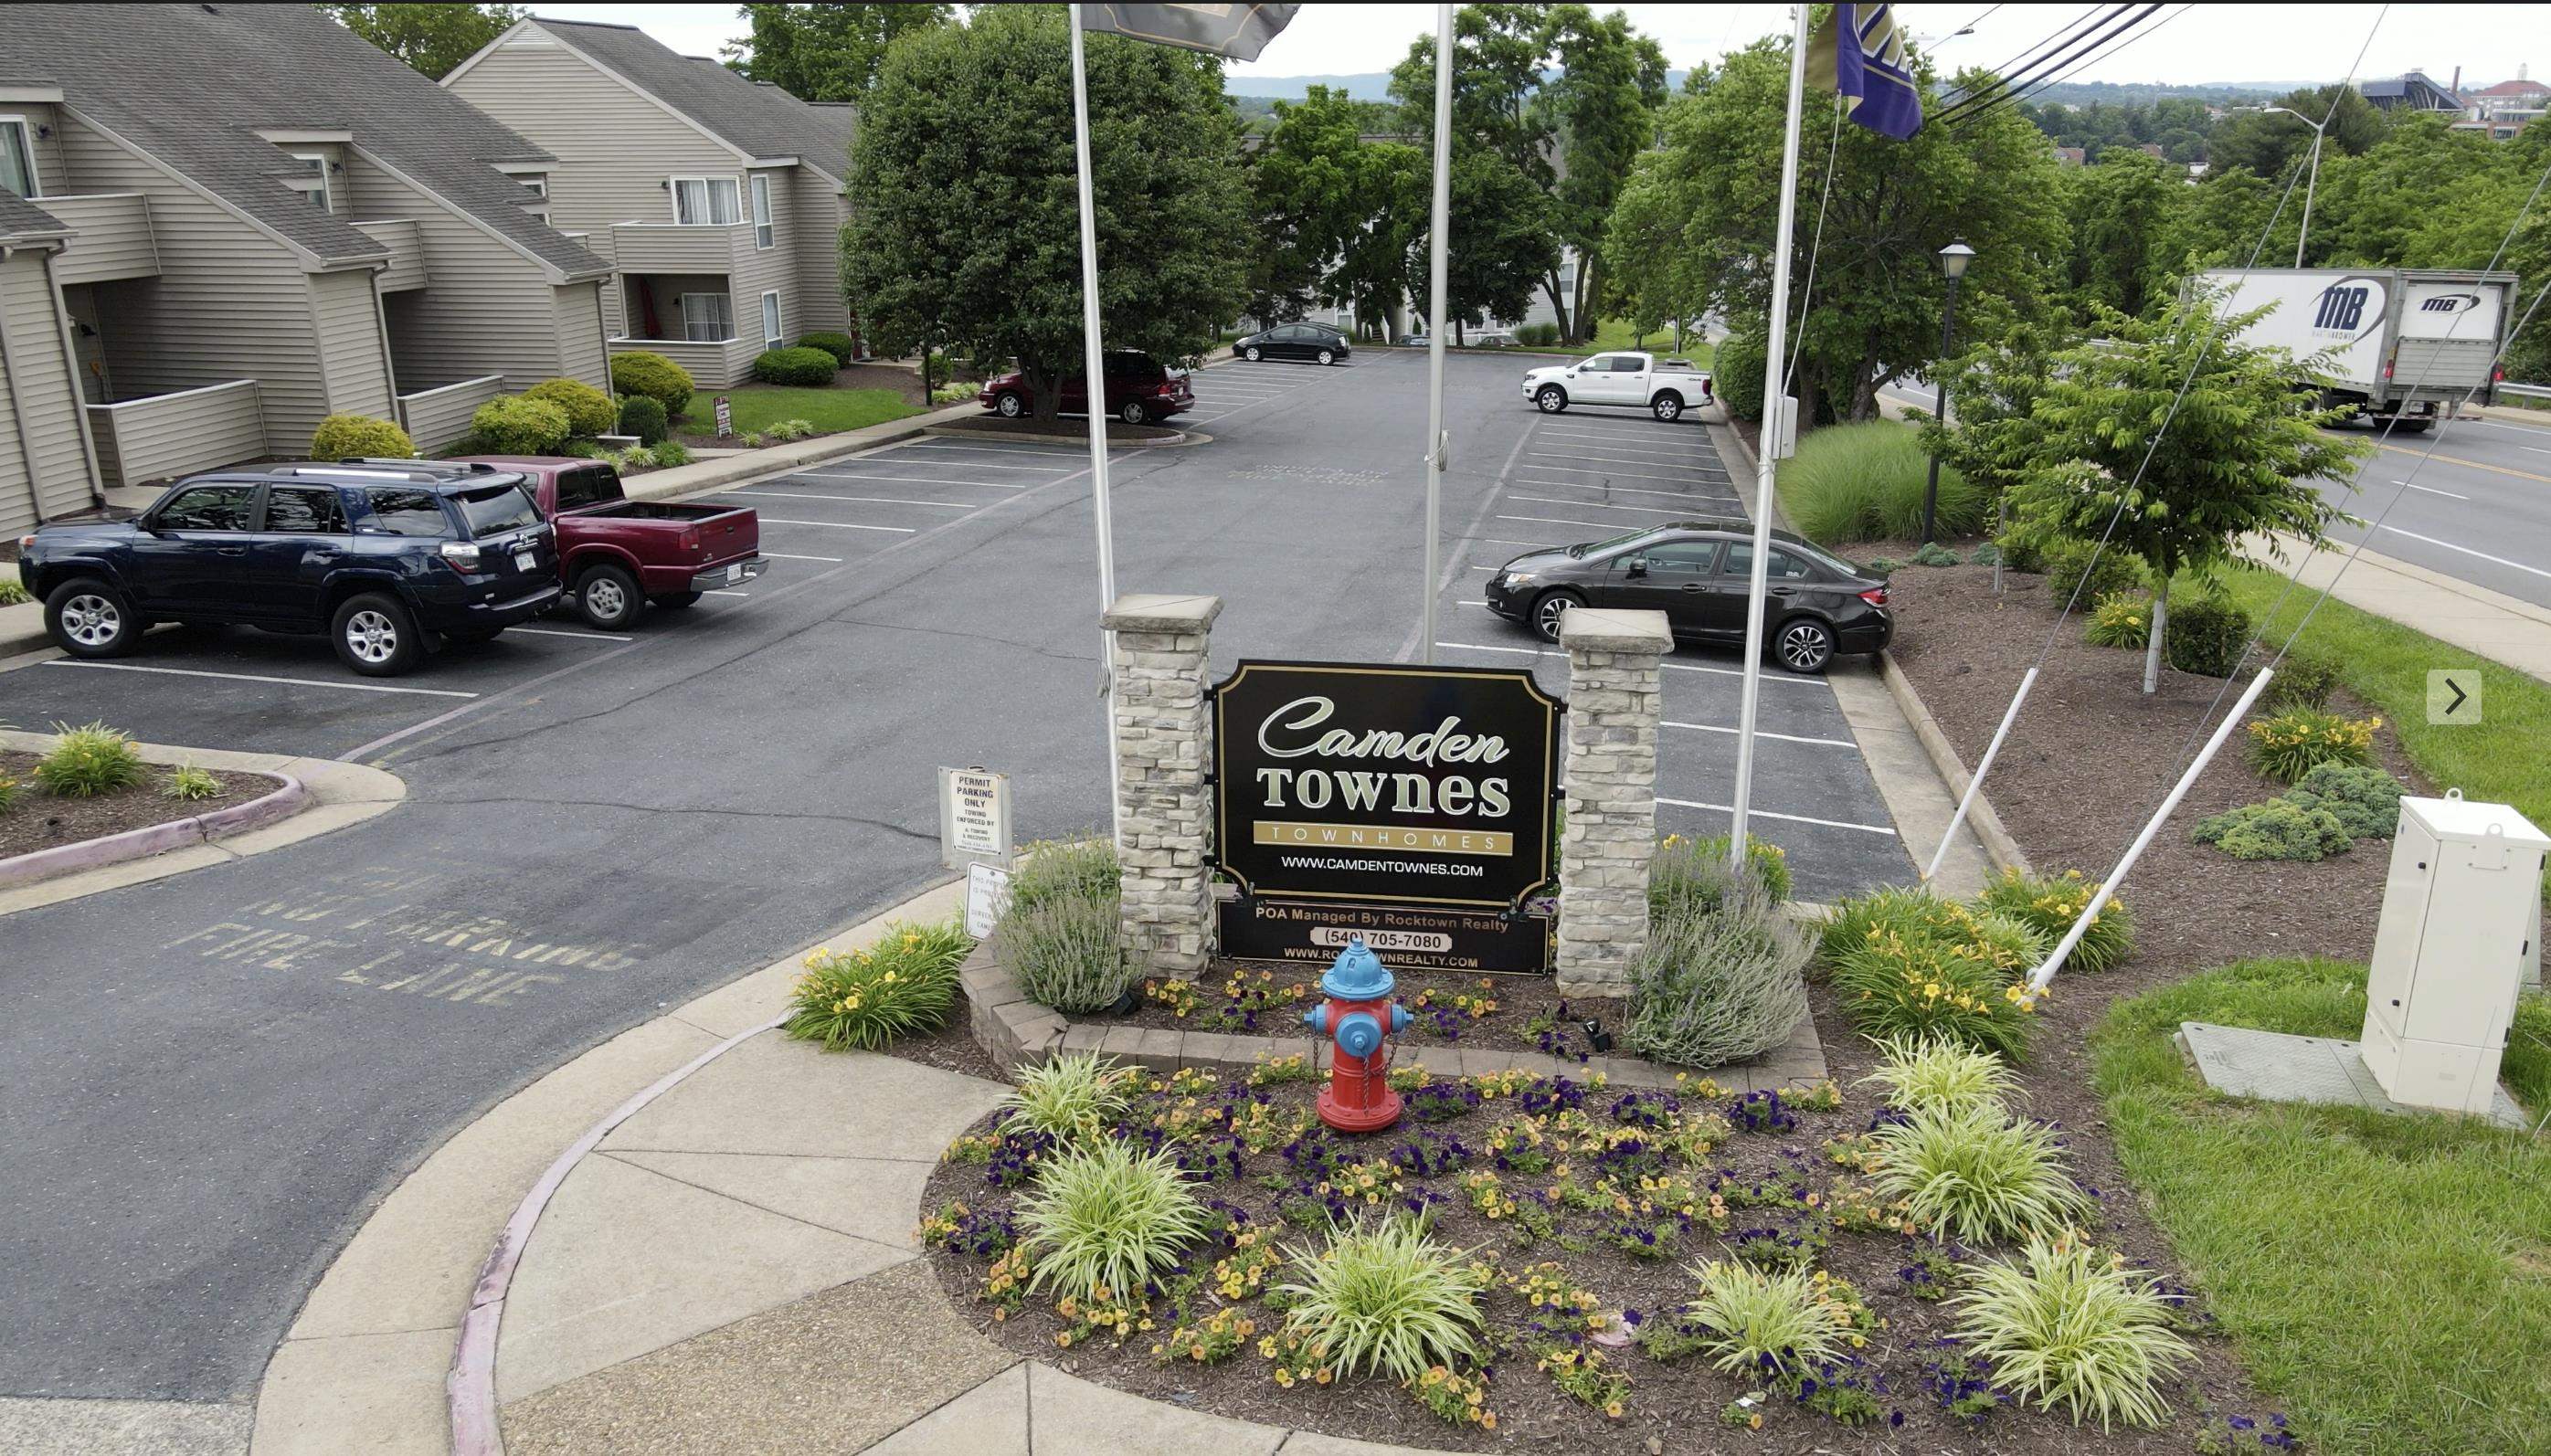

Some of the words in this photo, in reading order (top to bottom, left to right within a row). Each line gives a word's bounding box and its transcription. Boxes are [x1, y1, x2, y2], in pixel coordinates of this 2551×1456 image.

[2313, 286, 2369, 330] MB
[2420, 298, 2458, 311] MB
[1258, 696, 1509, 767] Camden
[958, 776, 990, 786] PERMIT
[957, 786, 993, 798] PARKING
[964, 797, 986, 807] ONLY
[1272, 828, 1494, 849] TOWNHOMES
[1281, 856, 1484, 877] WWW.CAMDENTOWNES.COM
[1255, 907, 1287, 920] POA
[1291, 909, 1356, 924] Managed
[1361, 913, 1381, 926] By
[1385, 913, 1457, 929] Rocktown
[1463, 918, 1508, 933] Realty
[1371, 933, 1441, 949] 705-7080
